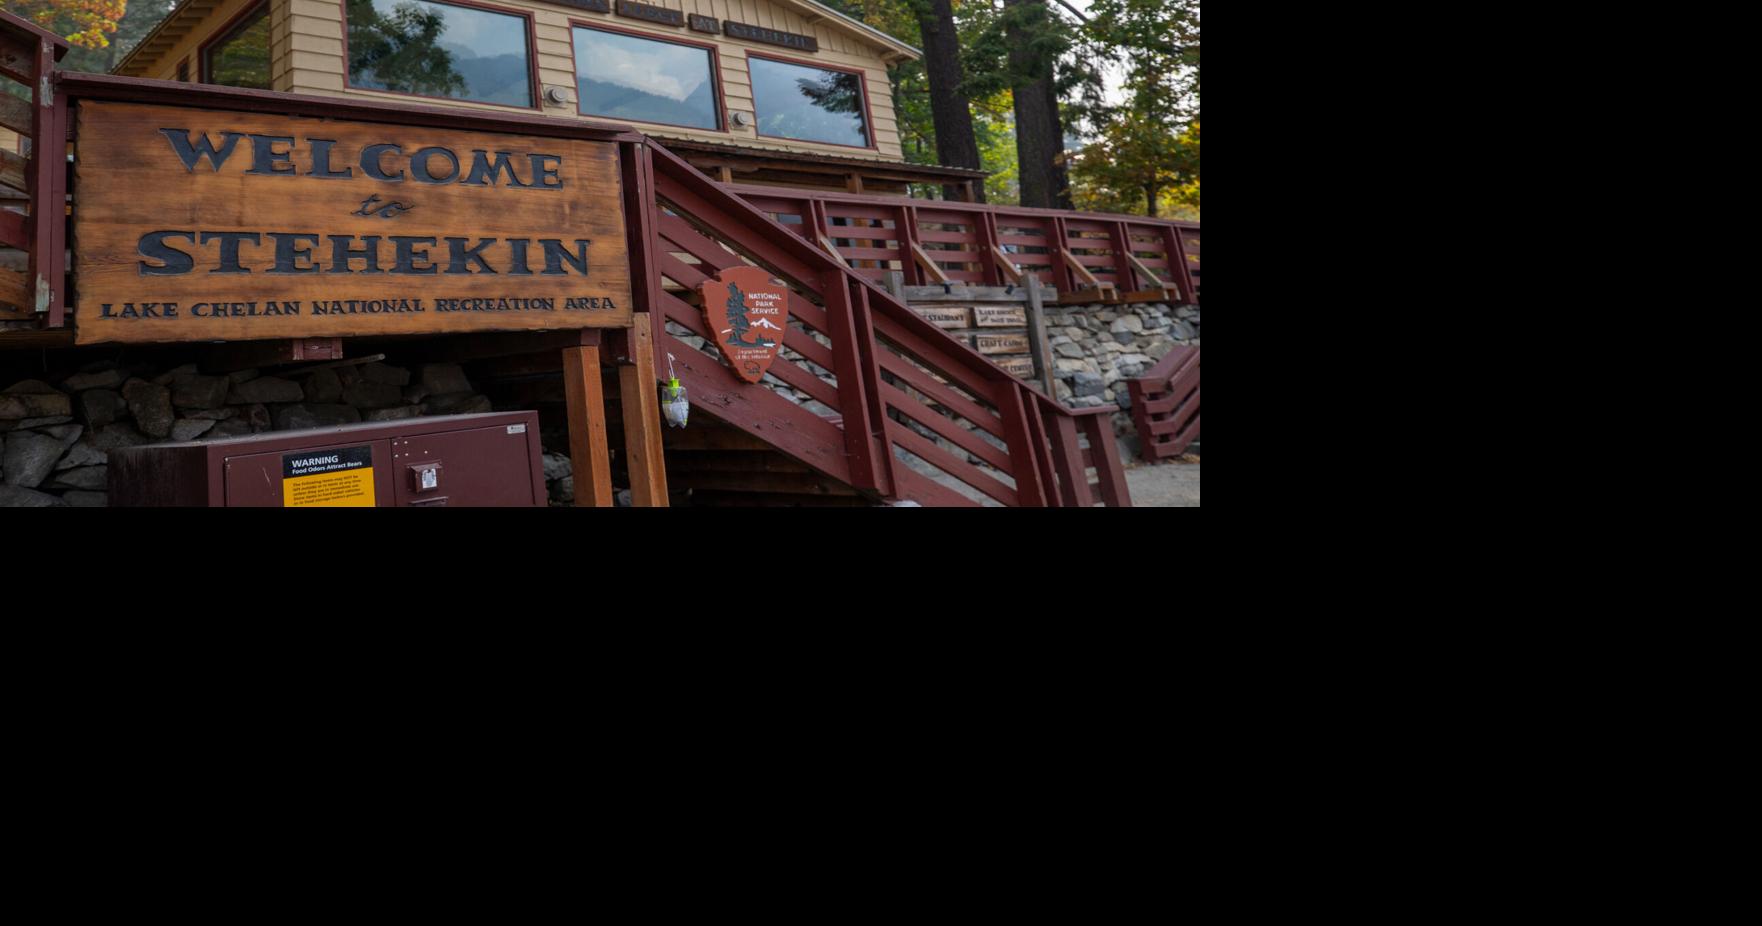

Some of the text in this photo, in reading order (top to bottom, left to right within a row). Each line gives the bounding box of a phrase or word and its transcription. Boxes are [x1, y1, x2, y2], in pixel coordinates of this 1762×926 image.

[158, 127, 564, 190] WELCOME
[350, 193, 414, 219] to
[136, 230, 592, 276] STEHEKIN
[101, 296, 616, 318] LAKE CHELAN NATIONAL RECREATION AREA
[748, 292, 782, 300] NATIONAL
[292, 455, 339, 468] WARNING
